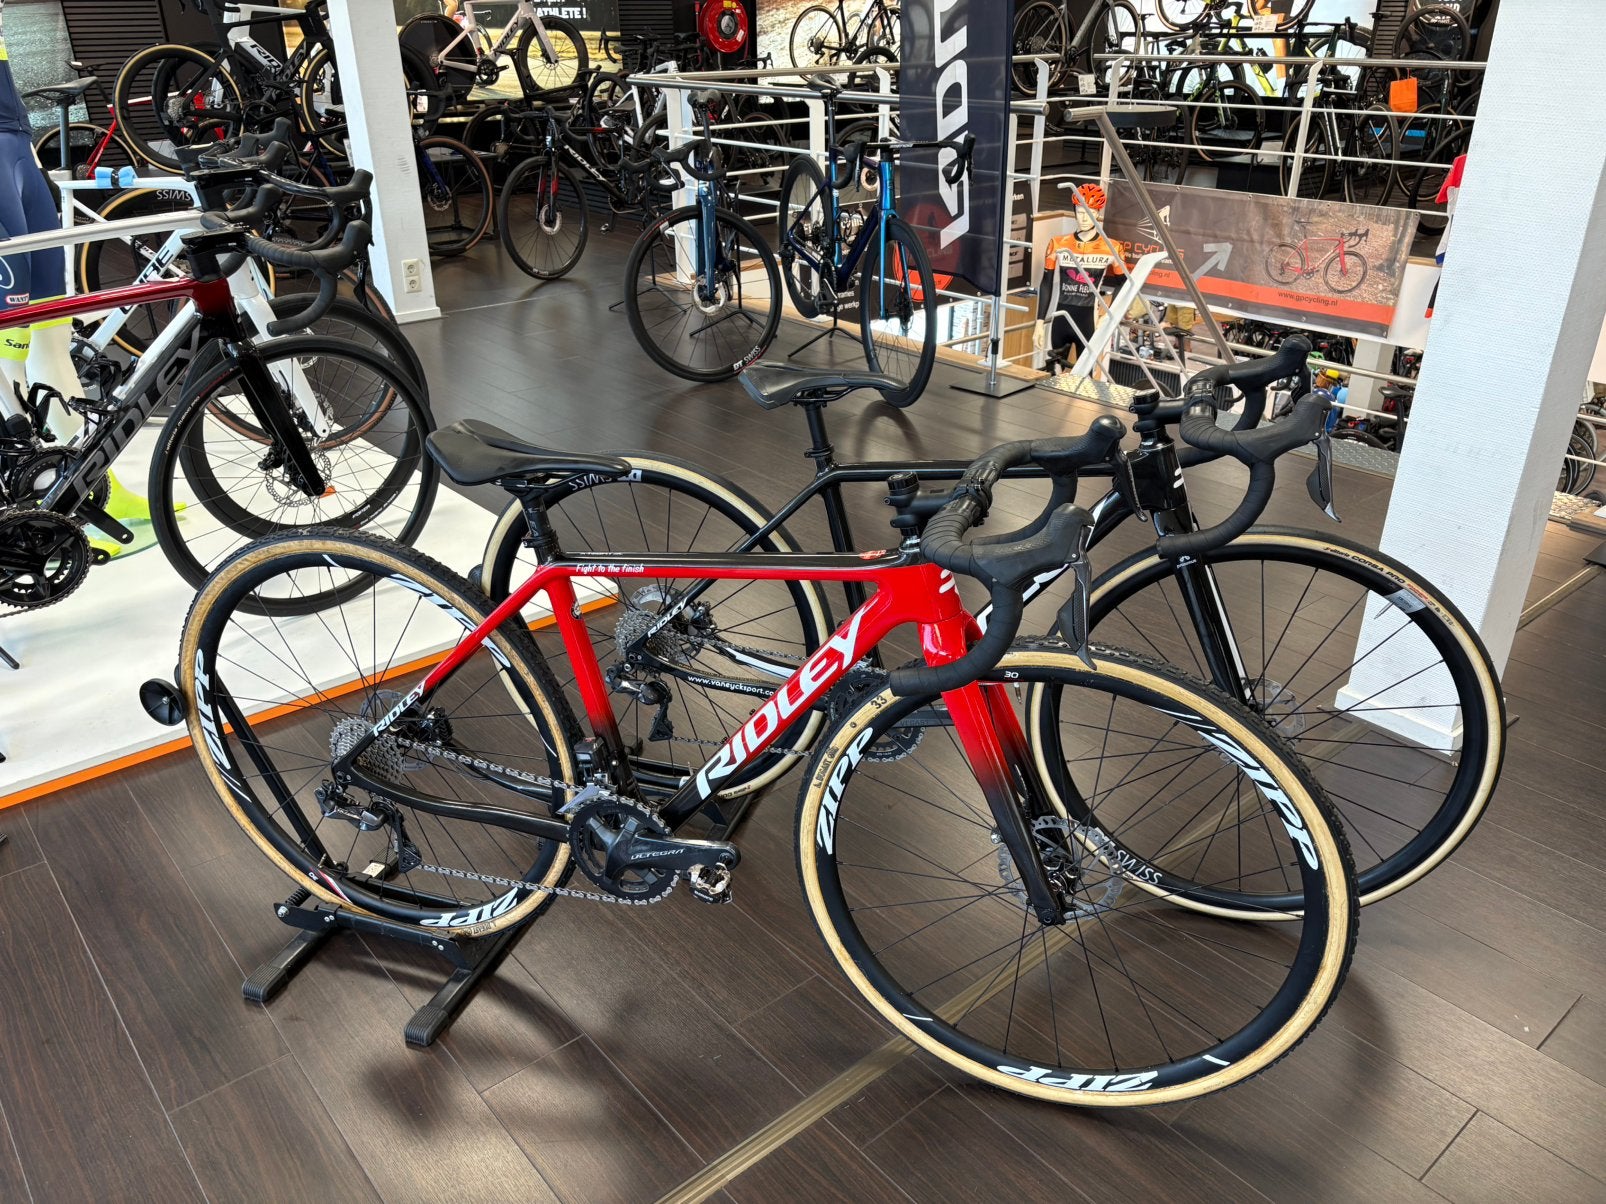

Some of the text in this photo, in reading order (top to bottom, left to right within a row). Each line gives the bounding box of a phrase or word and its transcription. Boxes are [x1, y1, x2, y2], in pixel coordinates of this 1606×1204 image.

[156, 189, 192, 201] SWISS
[1277, 290, 1339, 307] www.gpcycling.nl
[743, 345, 761, 364] SWISS
[72, 326, 201, 497] RIDLEY
[575, 563, 645, 575] Fight to the finish
[1350, 555, 1385, 573] CORSA
[1385, 570, 1406, 584] PRO
[647, 598, 688, 638] RIDLEY
[1003, 670, 1019, 680] 30
[194, 648, 231, 770] ZIPP
[372, 681, 425, 737] RIDLEY
[696, 602, 874, 801] RIDLEY
[870, 695, 888, 710] 33
[816, 726, 875, 855] ZIPP
[1197, 730, 1319, 870] ZIPP
[630, 848, 685, 860] ULTEGRA
[1116, 849, 1163, 885] SWISS
[419, 886, 520, 928] ZIPP
[995, 1063, 1159, 1093] ZIPP
